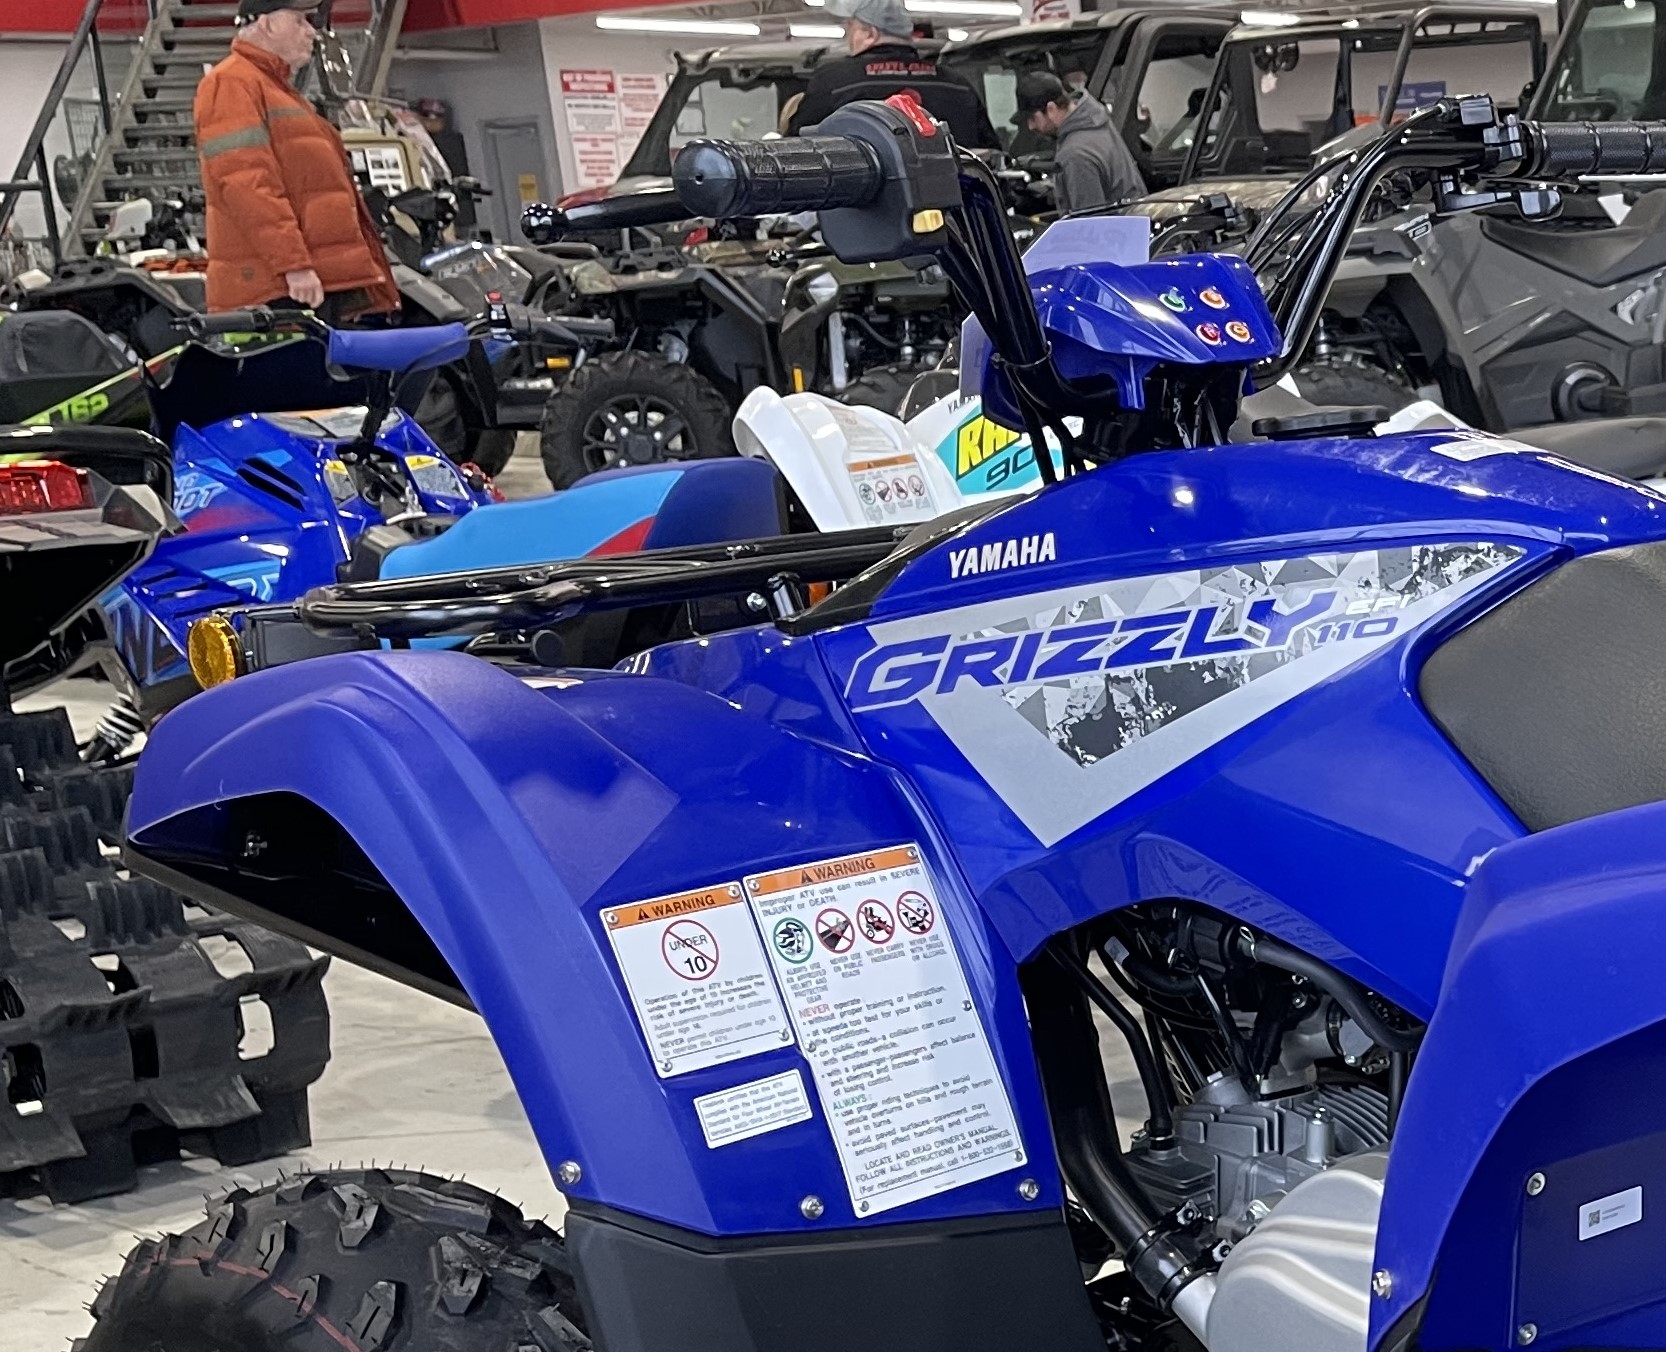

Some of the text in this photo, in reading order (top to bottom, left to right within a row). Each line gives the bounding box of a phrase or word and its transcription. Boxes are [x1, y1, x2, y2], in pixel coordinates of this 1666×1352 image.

[986, 445, 1034, 491] 90
[949, 532, 1056, 579] YAMAHA
[1346, 593, 1411, 616] EFI
[847, 591, 1399, 708] GRIZZLY 110
[814, 858, 875, 880] WARNING
[799, 890, 815, 898] ATV
[891, 868, 920, 879] SEVERE
[652, 895, 715, 917] WARNING
[669, 935, 708, 951] UNDER
[684, 955, 708, 974] 10
[799, 1004, 830, 1018] NEVER
[660, 1038, 684, 1048] NEVER
[856, 1168, 886, 1183] FOLLOW
[889, 1163, 902, 1172] ALL
[905, 1147, 954, 1167] INSTRUCTIONS
[957, 1141, 972, 1151] AND
[864, 1156, 892, 1170] LOCATE
[895, 1150, 910, 1160] AND
[912, 1144, 932, 1155] READ
[934, 1133, 966, 1148] OWNER'S
